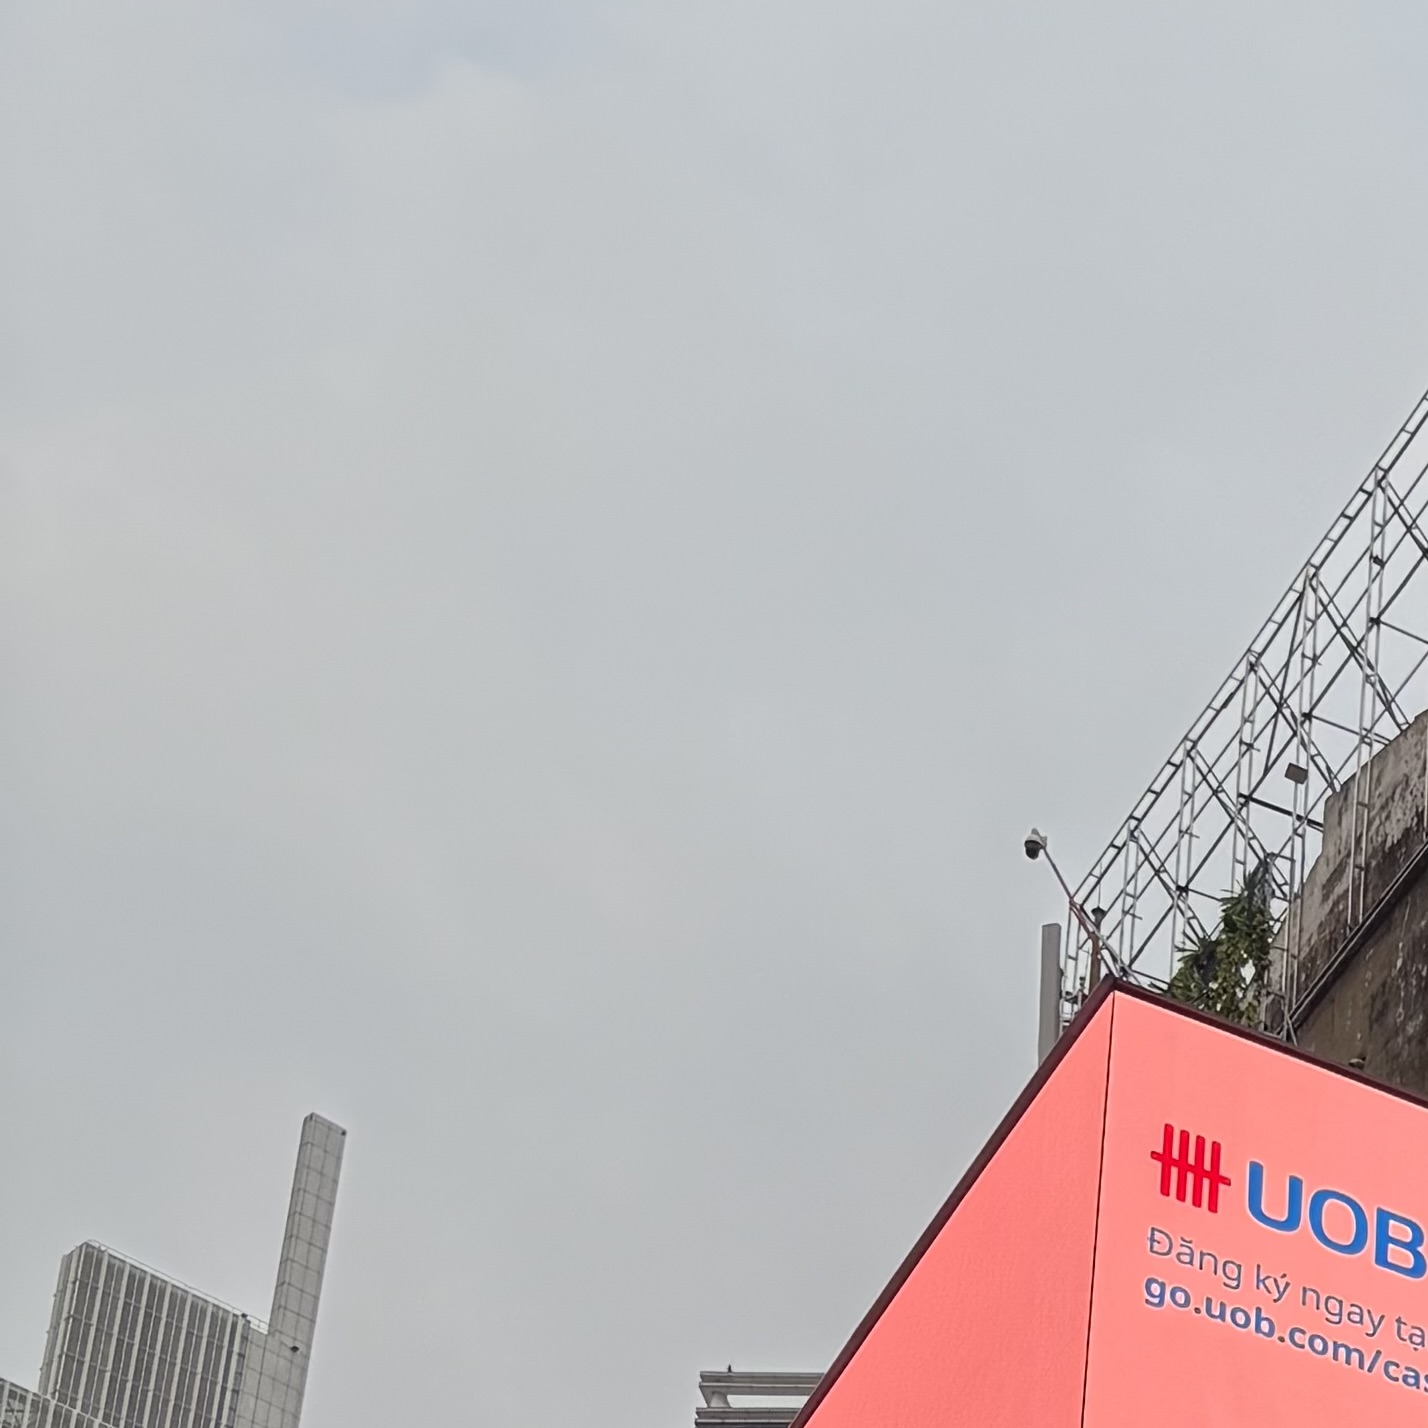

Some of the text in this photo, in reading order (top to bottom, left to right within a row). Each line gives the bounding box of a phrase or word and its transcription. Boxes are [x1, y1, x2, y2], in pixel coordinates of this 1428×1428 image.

[1247, 1159, 1428, 1280] UOB
[1147, 1226, 1243, 1289] Đăng
[1256, 1264, 1289, 1303] ký
[1301, 1285, 1385, 1338] ngay
